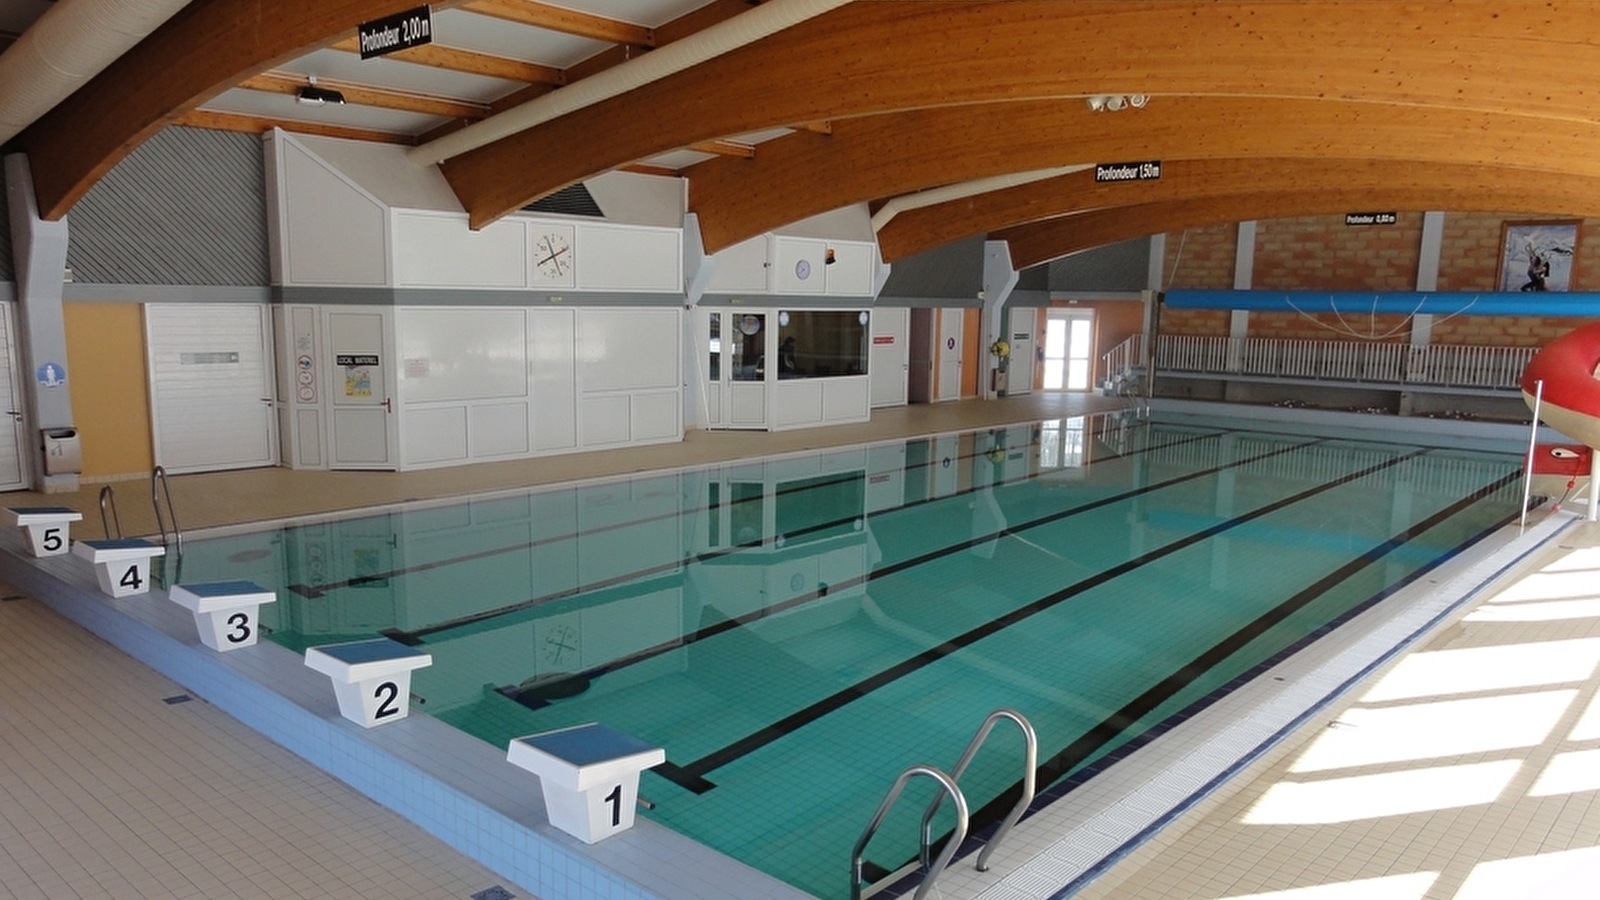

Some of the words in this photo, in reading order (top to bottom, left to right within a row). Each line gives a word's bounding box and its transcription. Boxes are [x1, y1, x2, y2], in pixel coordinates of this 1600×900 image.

[361, 25, 399, 52] Profondeur
[402, 16, 420, 45] 2,00
[1097, 165, 1138, 180] Profondeur
[1347, 215, 1374, 223] Profondeur
[43, 528, 62, 551] 5
[120, 565, 142, 589] 4
[227, 613, 250, 643] 3
[374, 682, 399, 719] 2
[605, 784, 622, 827] 1
